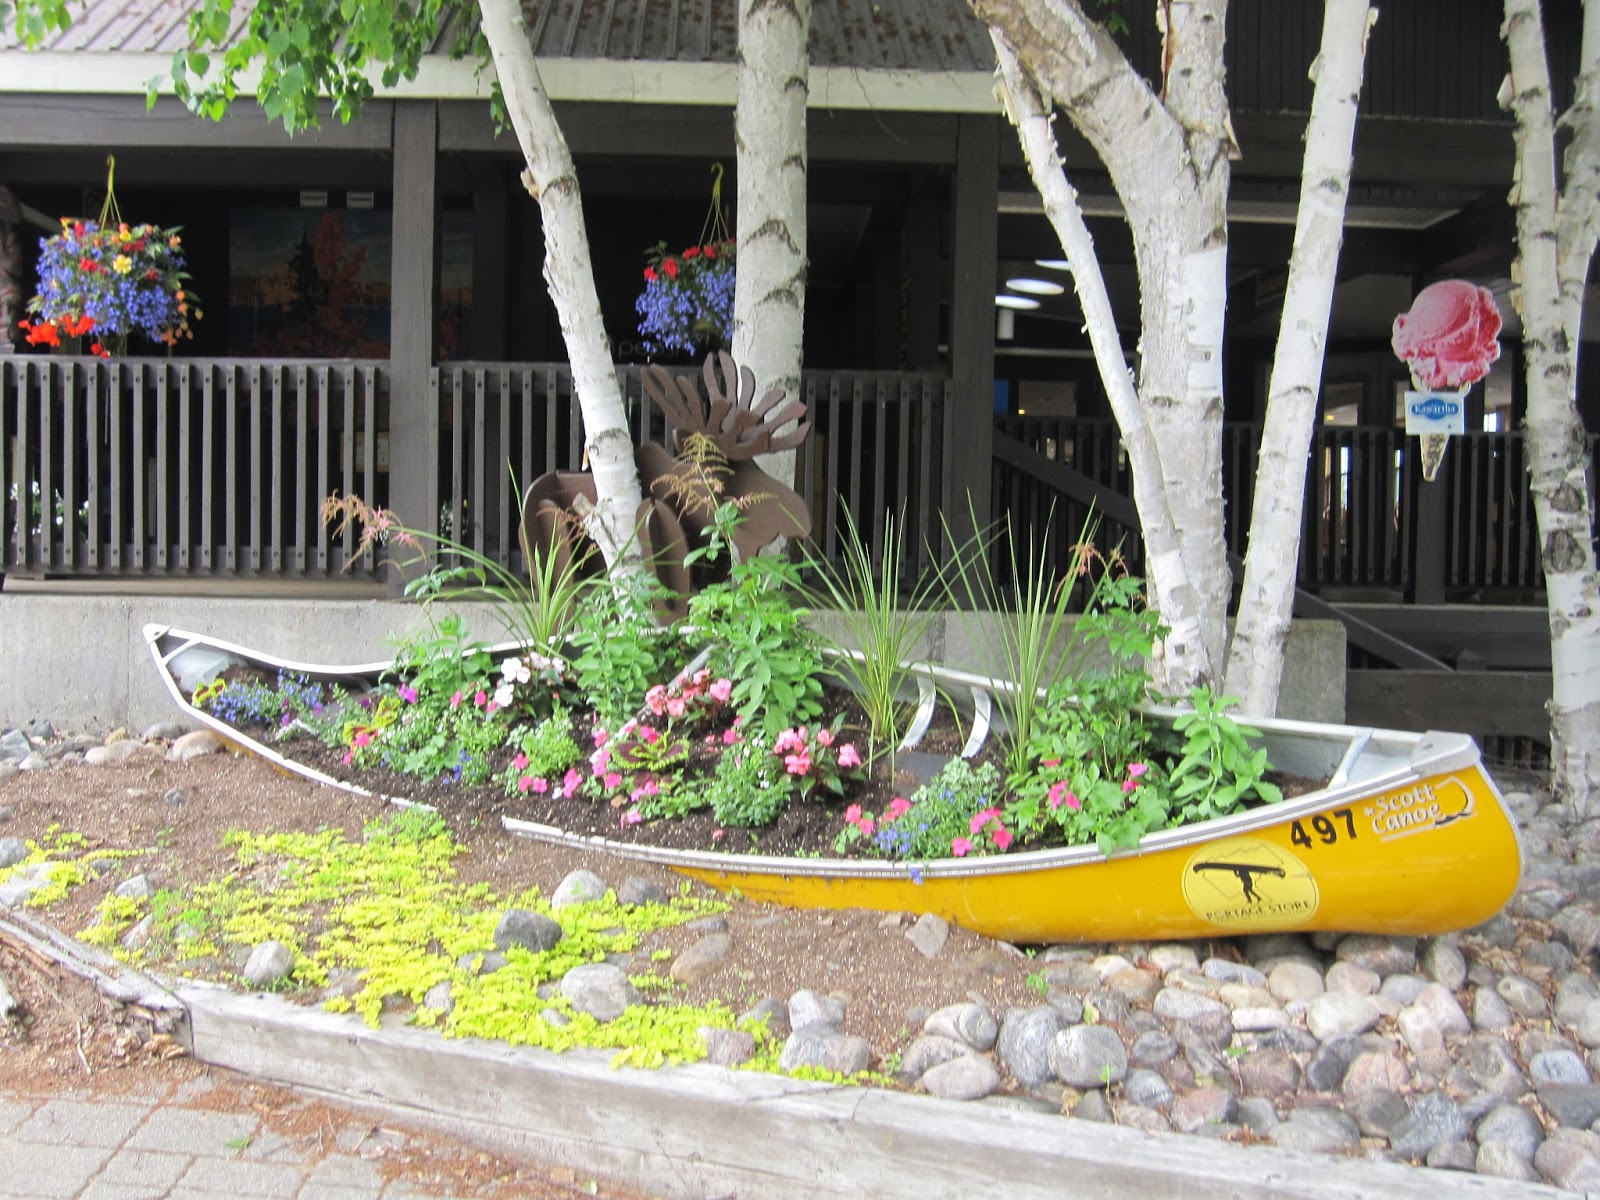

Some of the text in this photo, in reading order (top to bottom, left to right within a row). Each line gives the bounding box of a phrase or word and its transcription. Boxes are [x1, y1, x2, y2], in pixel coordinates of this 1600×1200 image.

[1376, 783, 1436, 811] Scott
[1291, 808, 1357, 849] 497
[1372, 804, 1441, 834] Canoe
[1205, 906, 1263, 921] PORTAGE
[1268, 900, 1310, 914] STORE
